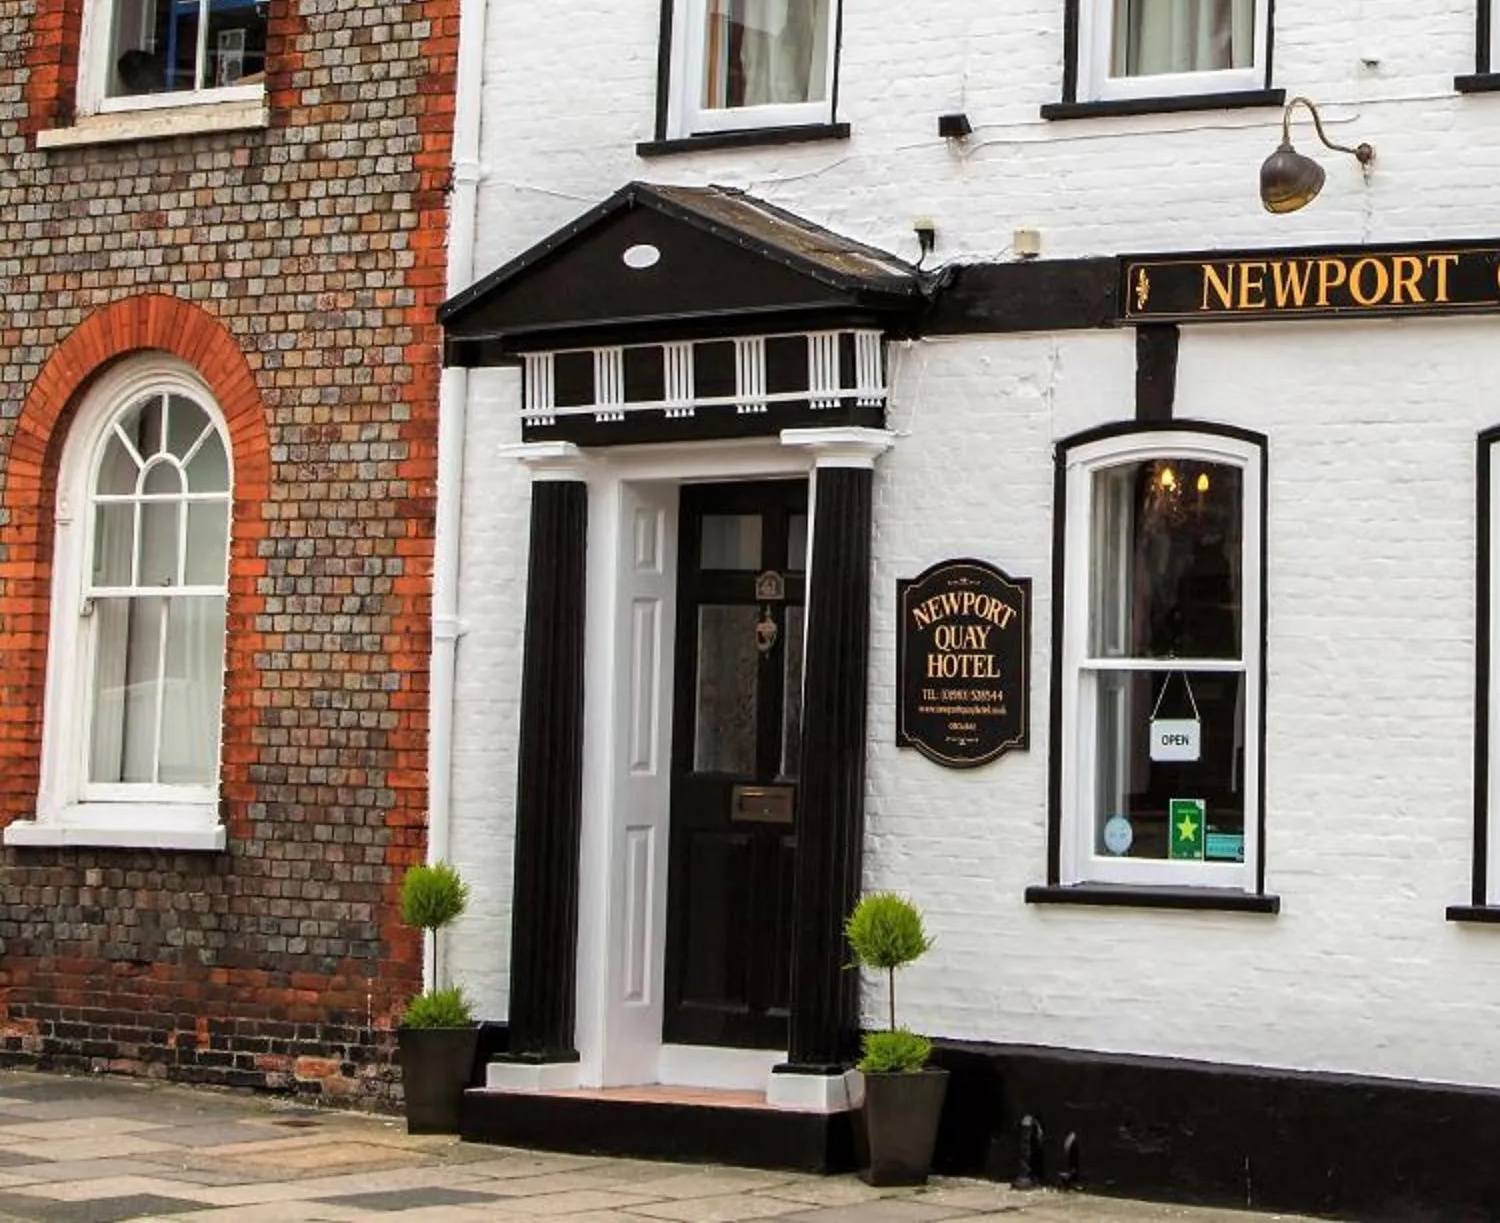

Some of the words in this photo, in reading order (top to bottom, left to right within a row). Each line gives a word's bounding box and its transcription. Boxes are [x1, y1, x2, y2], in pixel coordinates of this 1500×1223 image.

[1200, 254, 1458, 310] NEWPORT
[912, 591, 1017, 630] NEWPORT
[934, 624, 991, 652] QUAY
[927, 653, 1001, 679] HOTEL
[1161, 734, 1190, 746] OPEN
